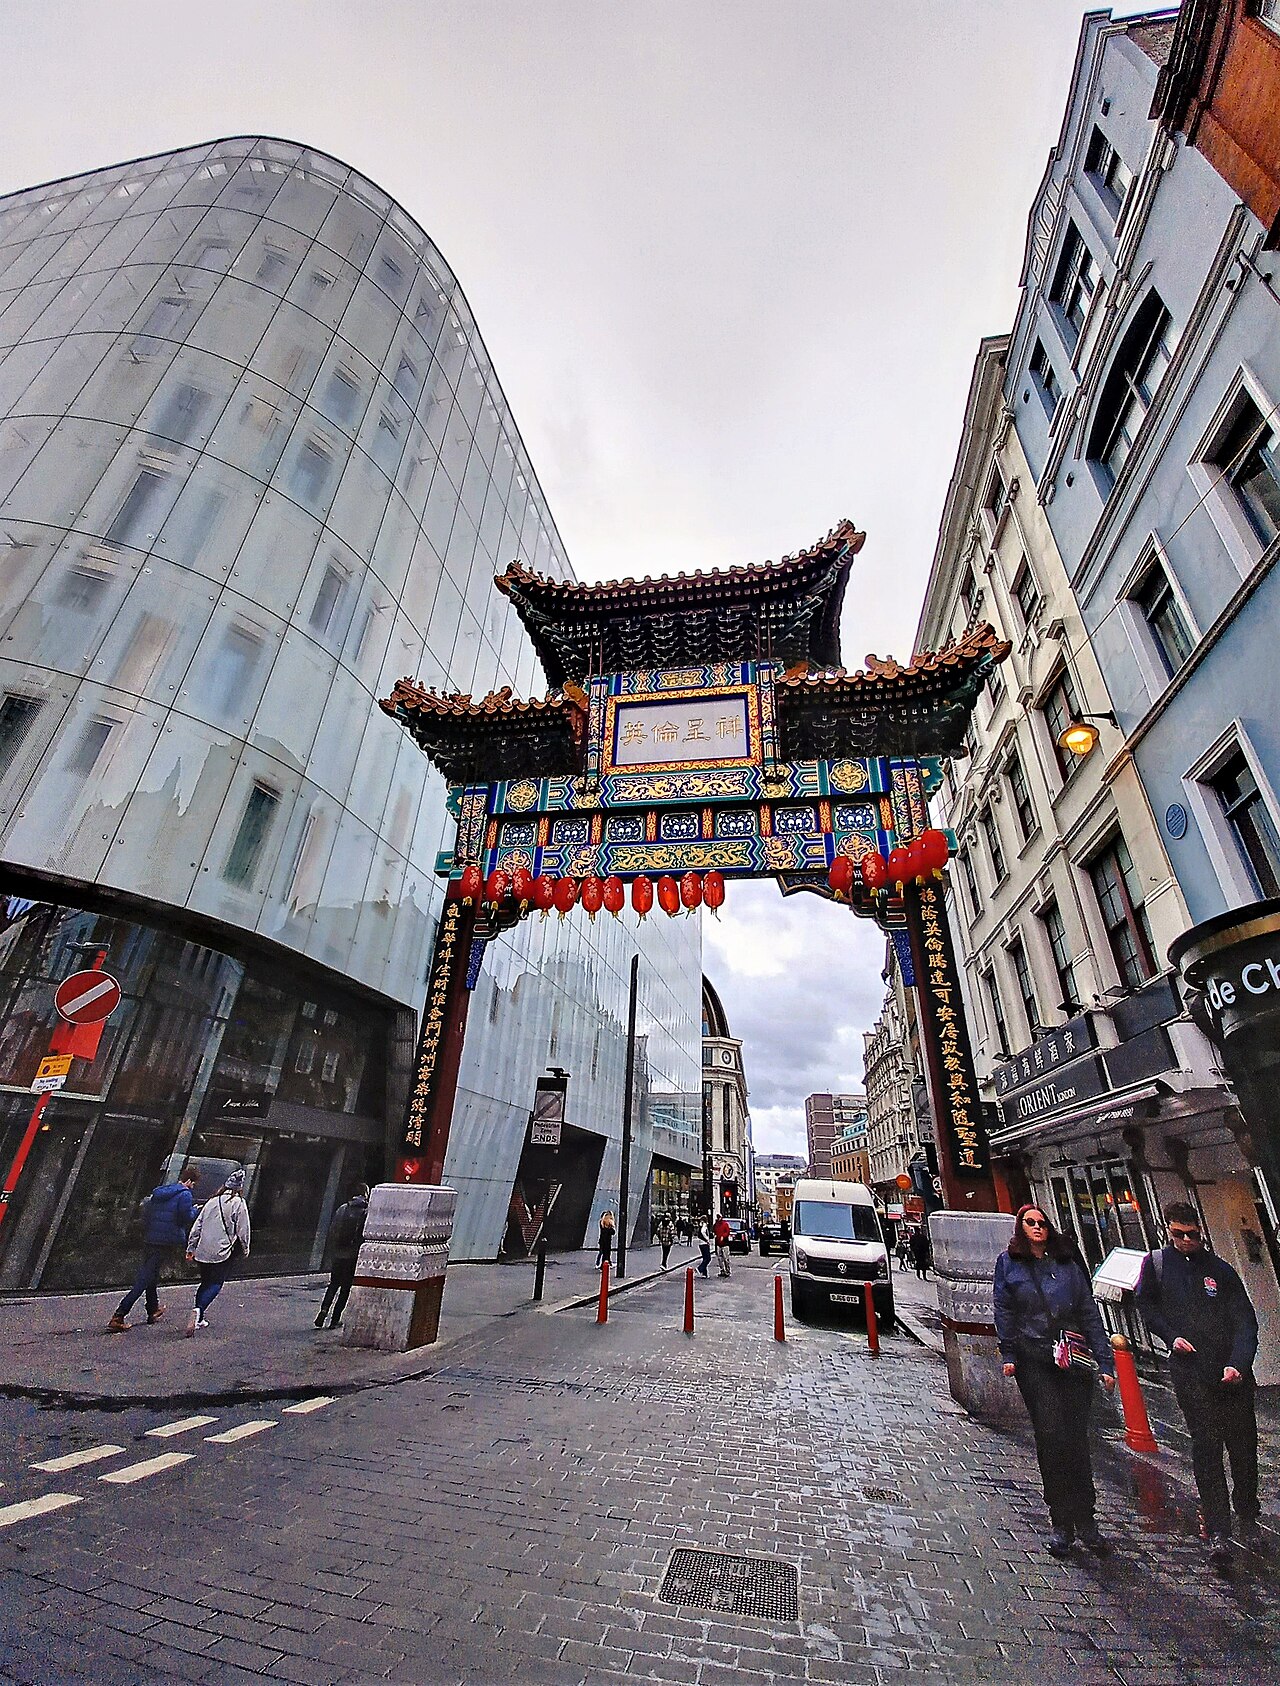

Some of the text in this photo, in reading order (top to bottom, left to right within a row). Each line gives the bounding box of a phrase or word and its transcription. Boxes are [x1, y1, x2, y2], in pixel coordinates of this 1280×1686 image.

[1019, 1083, 1057, 1117] ORIENT
[1056, 1086, 1077, 1104] LONDON
[532, 1134, 557, 1142] ENDS
